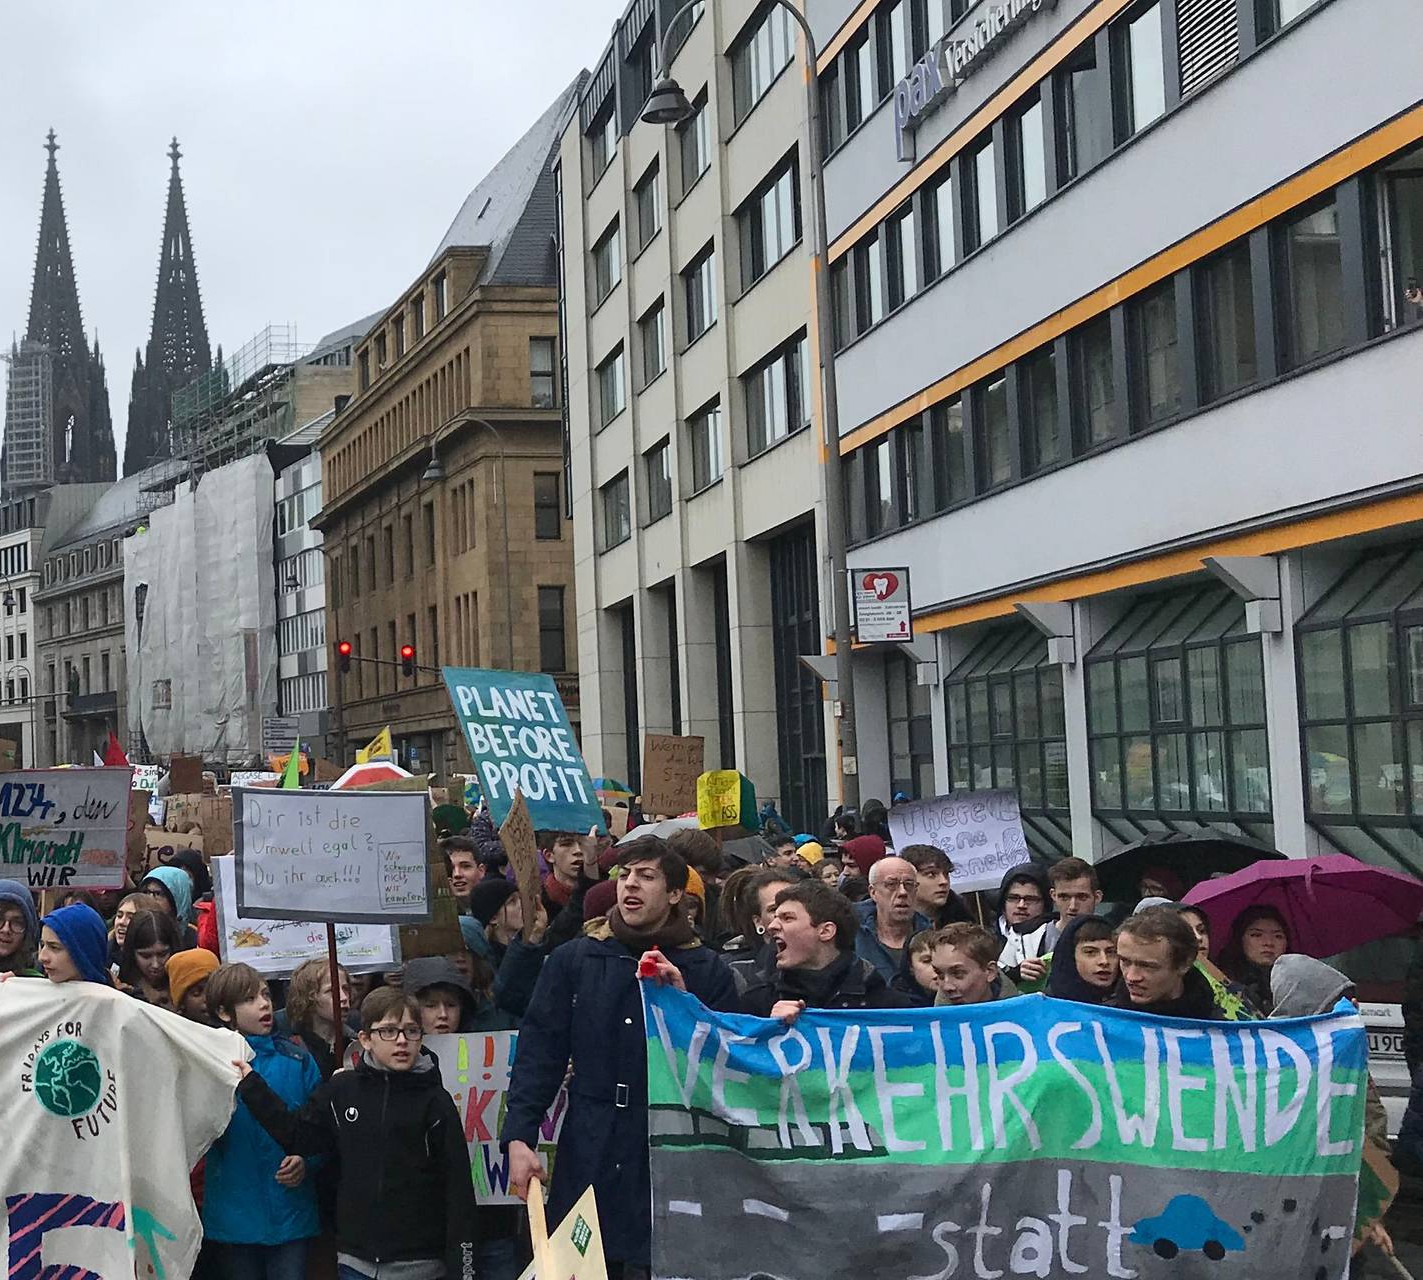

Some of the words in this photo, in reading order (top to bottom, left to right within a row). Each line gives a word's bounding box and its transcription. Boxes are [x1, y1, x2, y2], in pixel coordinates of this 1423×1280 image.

[455, 685, 560, 724] PLANET
[466, 721, 575, 764] BEFORE
[481, 760, 589, 806] PROFIT
[248, 798, 286, 829] Dir
[298, 804, 322, 828] ist
[329, 813, 361, 835] die
[253, 837, 314, 857] Umwelt
[27, 866, 77, 888] WIR
[254, 861, 275, 886] Du
[283, 864, 306, 884] ihr
[57, 1021, 83, 1037] FOR
[22, 1030, 51, 1093] FRIDAYS
[651, 1003, 1366, 1157] VERKEHRSWENDE
[929, 1169, 1141, 1280] statt
